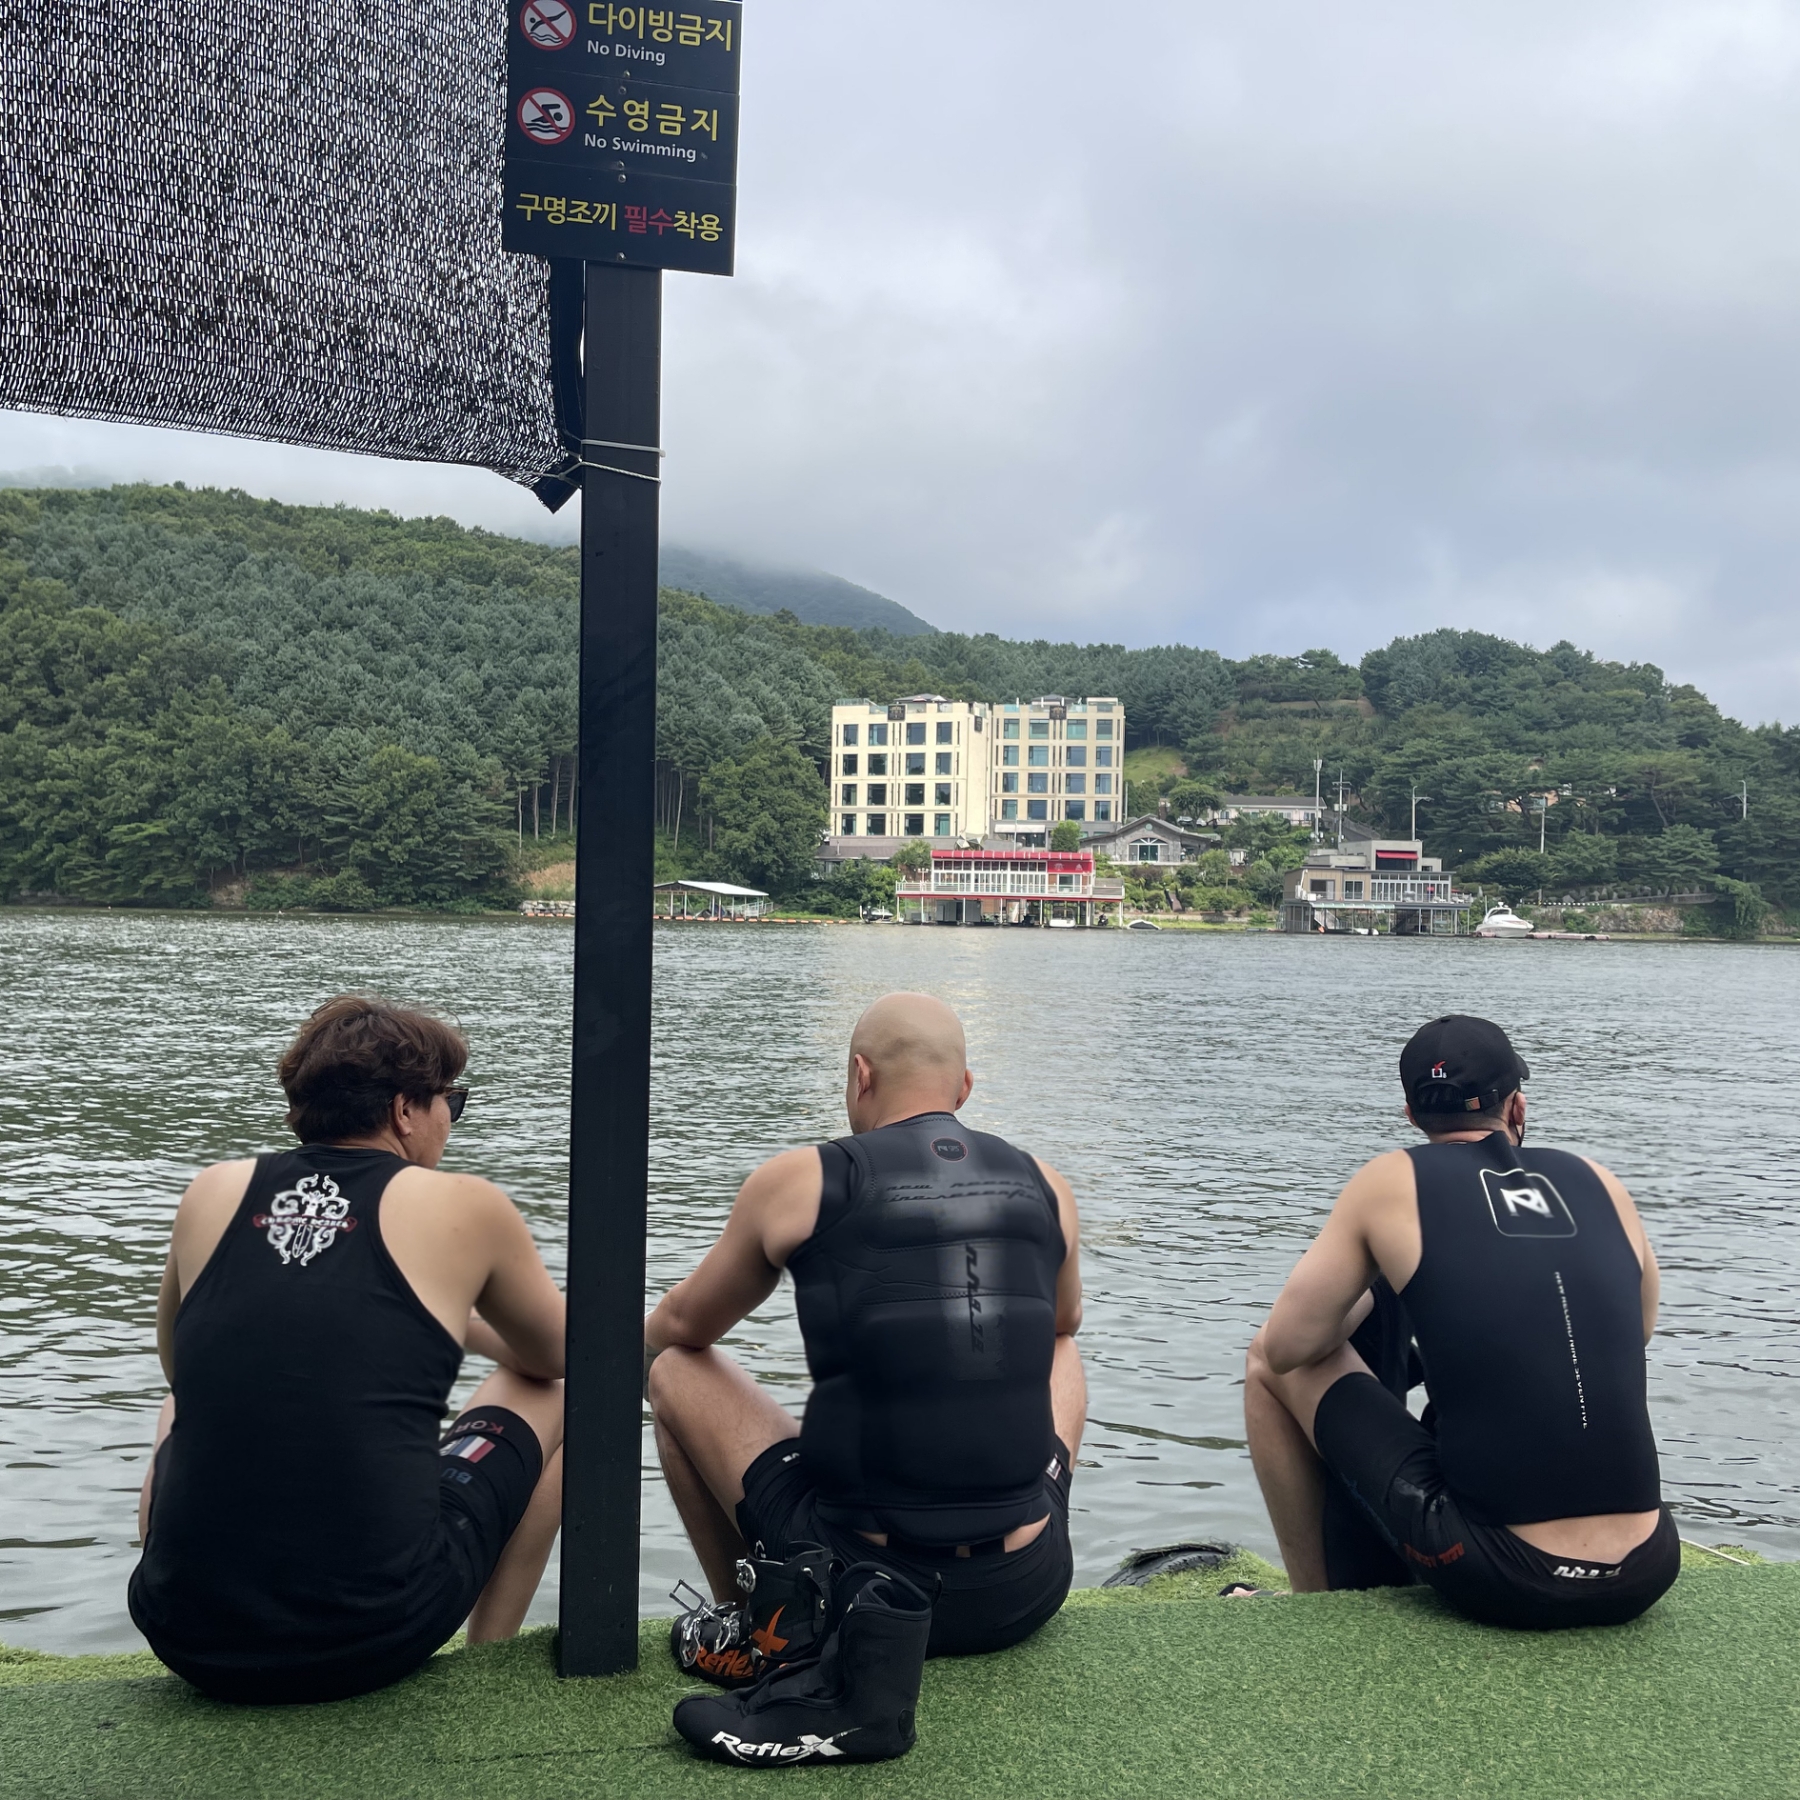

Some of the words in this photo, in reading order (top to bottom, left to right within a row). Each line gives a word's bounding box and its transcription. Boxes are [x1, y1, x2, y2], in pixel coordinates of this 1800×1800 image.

[587, 2, 732, 52] 다이빙금지
[587, 40, 610, 55] No
[615, 43, 666, 66] Diving
[586, 94, 718, 141] 수영금지
[584, 133, 607, 148] No
[612, 137, 697, 162] Swimming
[516, 193, 617, 231] 구명조끼
[1569, 1339, 1577, 1364] NINE
